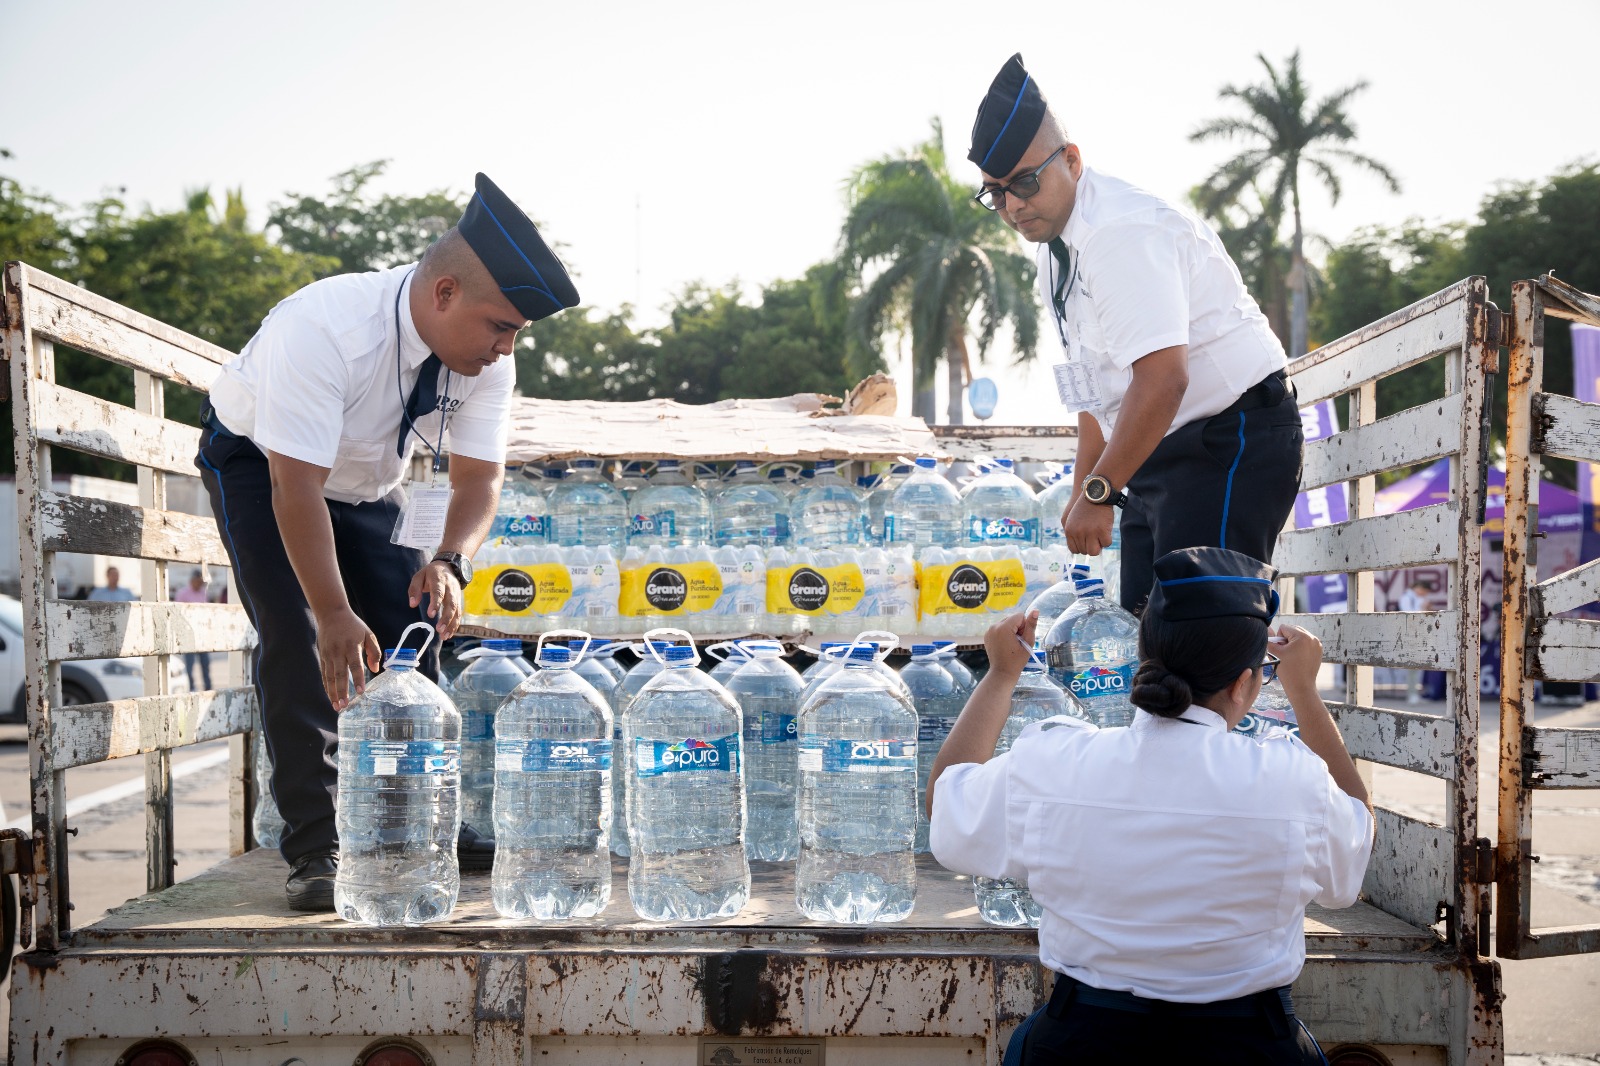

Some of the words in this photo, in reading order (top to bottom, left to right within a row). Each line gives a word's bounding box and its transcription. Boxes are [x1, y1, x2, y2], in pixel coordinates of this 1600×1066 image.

[539, 580, 555, 588] Agua
[832, 580, 847, 588] Agua
[949, 581, 987, 593] Grand
[993, 581, 1024, 589] Purificada
[494, 585, 533, 596] Grand
[646, 583, 685, 595] Grand
[789, 583, 827, 595] Grand
[651, 595, 683, 603] Brand
[792, 595, 825, 603] Brand
[783, 1047, 812, 1055] Remolques
